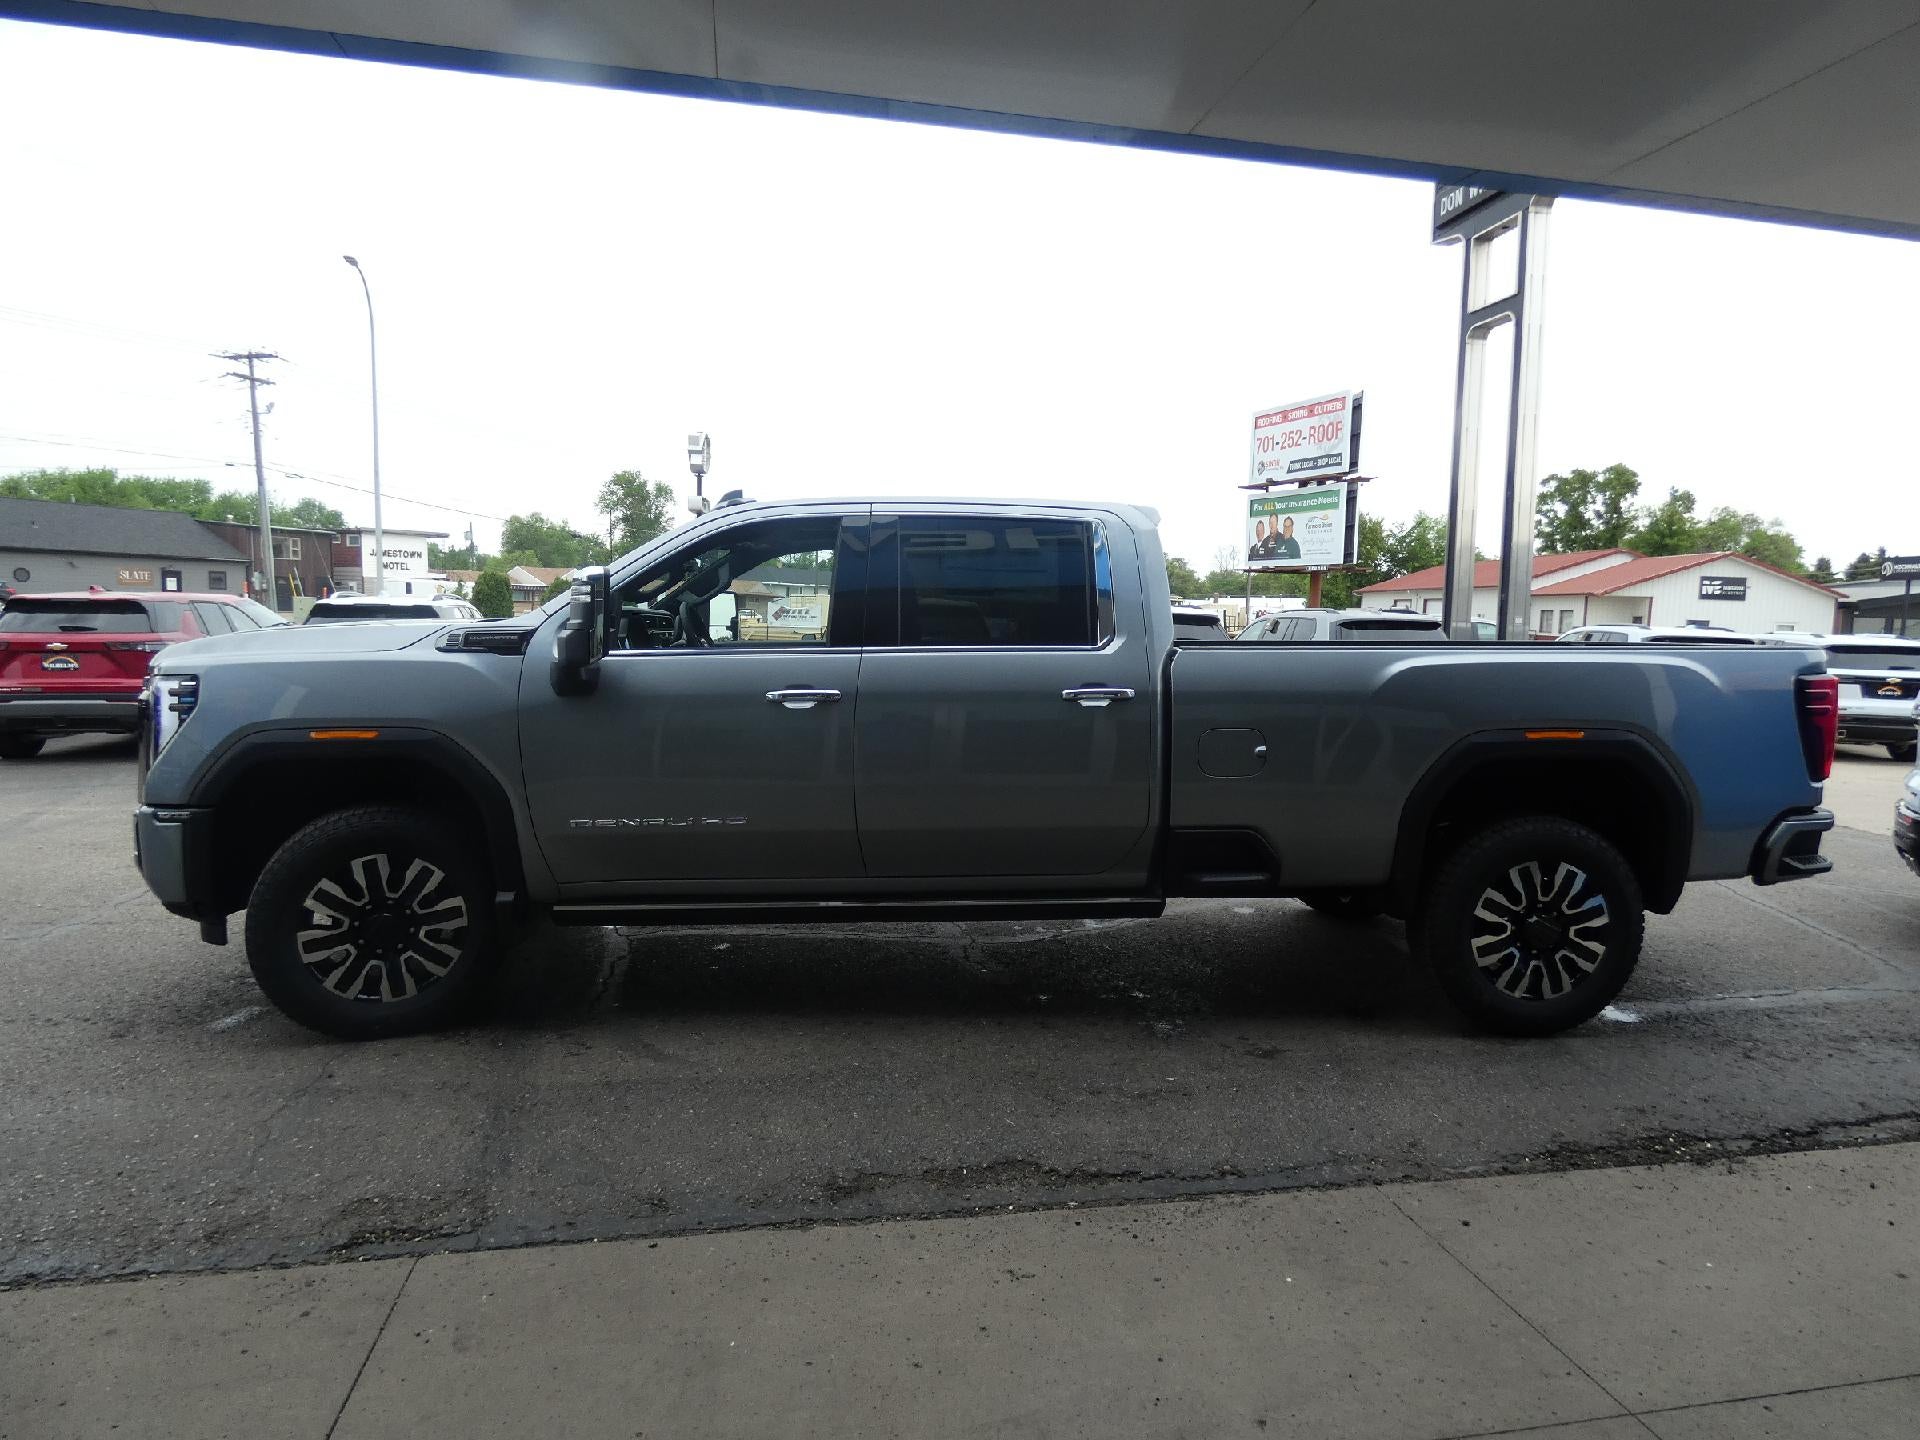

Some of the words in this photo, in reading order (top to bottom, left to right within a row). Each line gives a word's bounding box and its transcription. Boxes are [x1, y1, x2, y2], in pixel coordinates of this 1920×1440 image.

[1440, 186, 1463, 217] DON
[1257, 414, 1282, 427] ROOFING
[1287, 408, 1308, 420] SIDING
[1314, 400, 1343, 415] GUTTERS
[1256, 420, 1343, 455] 701-252-ROOF
[1301, 460, 1314, 469] LOCAL
[1329, 456, 1342, 464] LOCAL
[1264, 502, 1275, 511] ALL
[1318, 496, 1339, 505] Needs
[369, 548, 423, 559] JMESTOWN
[382, 561, 411, 571] MOTEL
[119, 569, 151, 580] SLATE
[569, 817, 694, 829] DENALI
